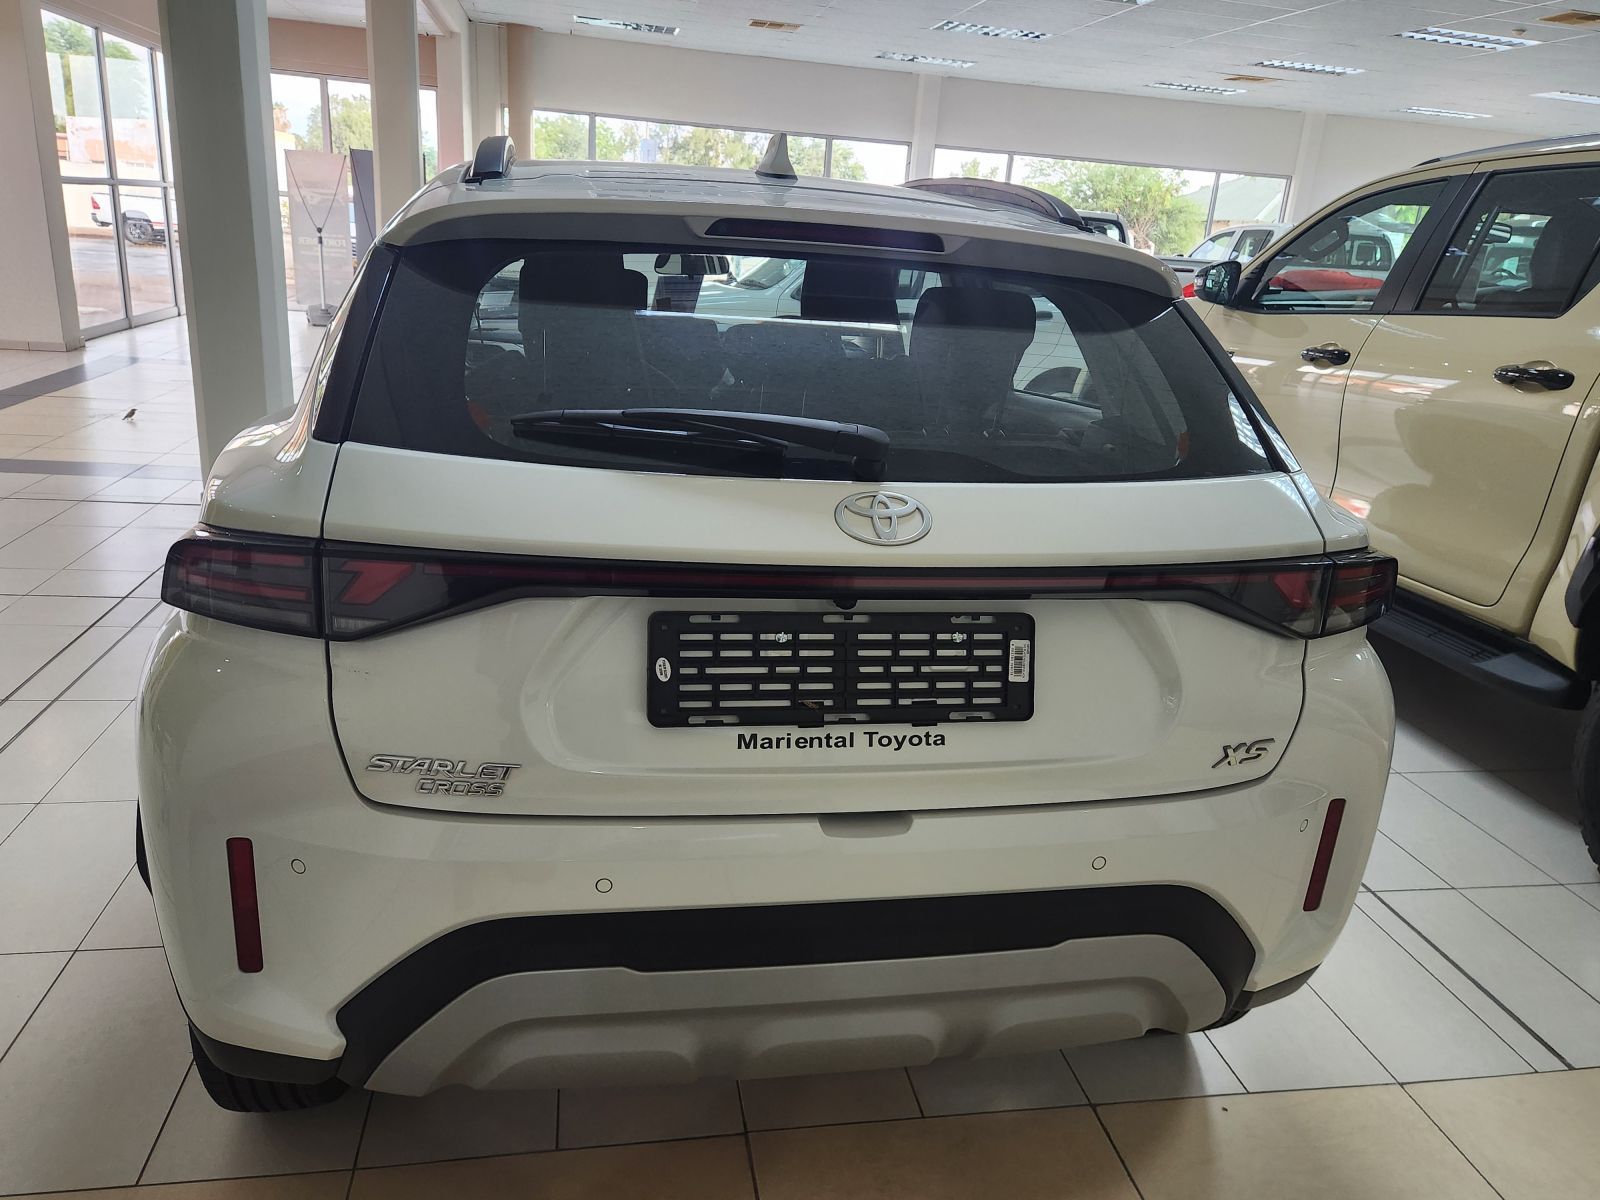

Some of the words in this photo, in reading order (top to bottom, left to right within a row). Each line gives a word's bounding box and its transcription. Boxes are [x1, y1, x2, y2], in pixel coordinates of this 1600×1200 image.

[737, 732, 855, 750] Mariental
[863, 731, 946, 751] Toyota
[1211, 738, 1275, 769] XS
[366, 754, 522, 782] STARLET
[415, 778, 506, 798] CROSS
